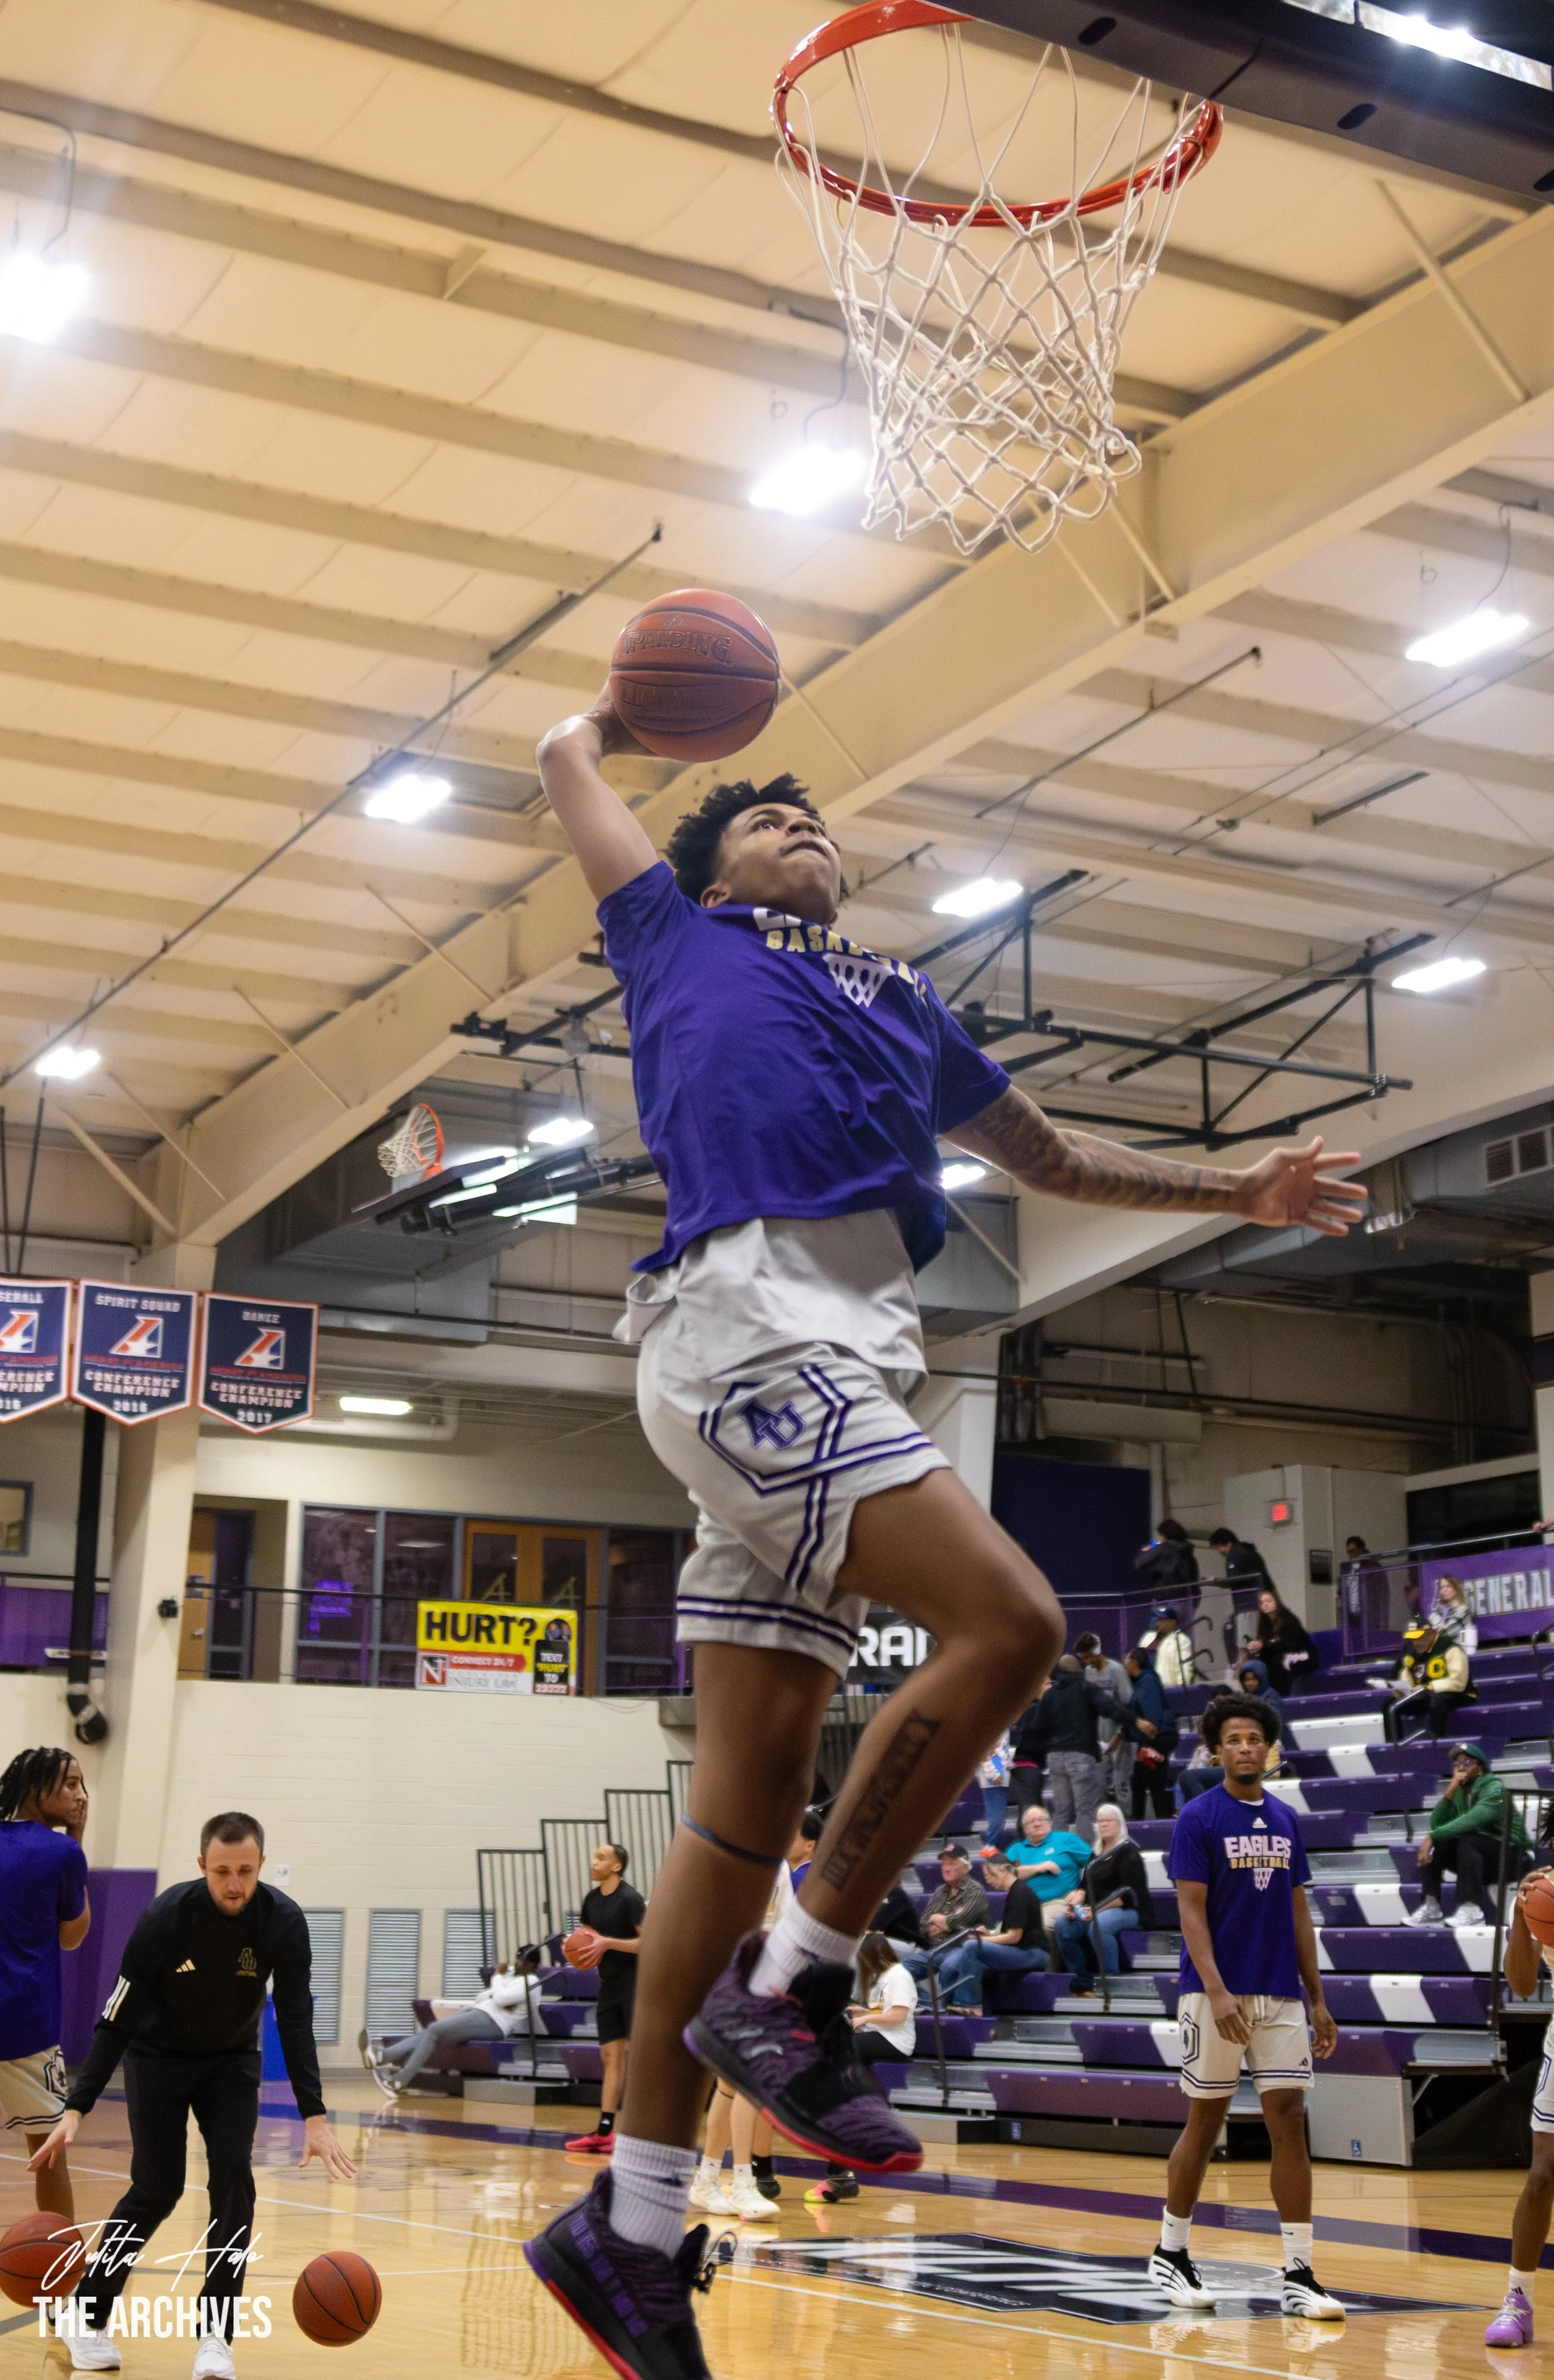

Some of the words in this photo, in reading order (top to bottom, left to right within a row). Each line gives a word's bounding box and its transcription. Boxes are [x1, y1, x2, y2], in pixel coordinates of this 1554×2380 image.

[95, 1293, 138, 1310] SPIRIT
[140, 1299, 182, 1313] SQUAD
[241, 1310, 280, 1324] DANCE
[85, 1369, 180, 1389] CONFERENCE
[93, 1381, 172, 1398] CHAMPION
[209, 1382, 303, 1400] CONFERENCE
[113, 1399, 148, 1413] 2016
[218, 1392, 294, 1408] CHAMPION
[236, 1408, 273, 1423] 2017
[1463, 1568, 1554, 1616] GENERAL
[425, 1611, 537, 1647] HURT?
[540, 1652, 563, 1663] TEXT
[1223, 1834, 1292, 1859] EAGLES
[1230, 1856, 1290, 1870] BASKETBALL
